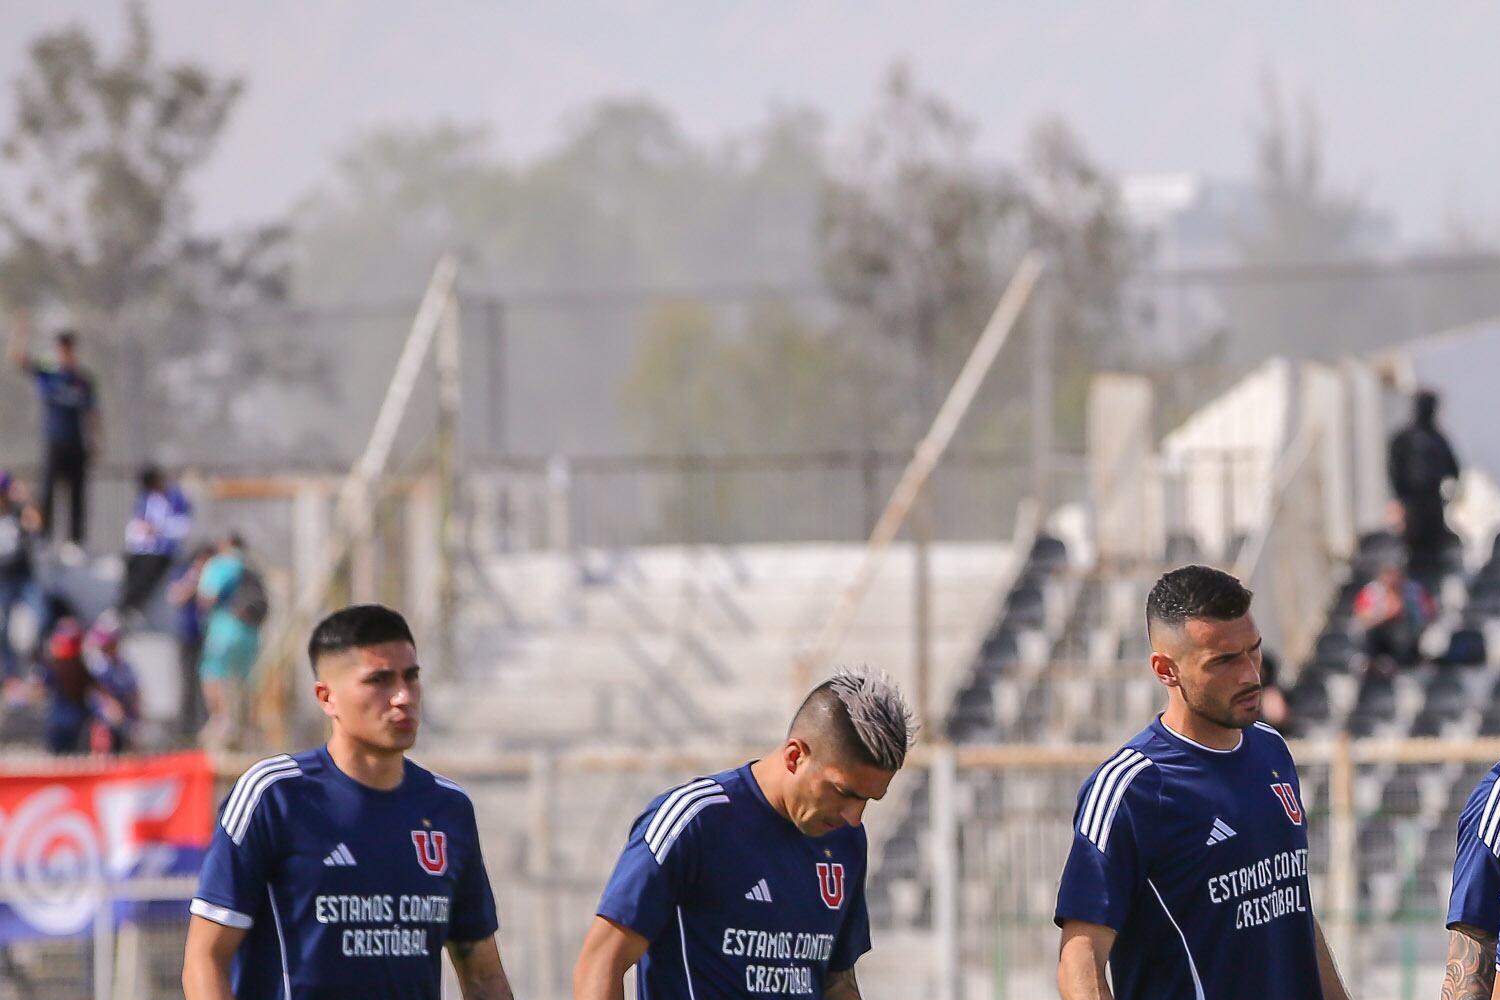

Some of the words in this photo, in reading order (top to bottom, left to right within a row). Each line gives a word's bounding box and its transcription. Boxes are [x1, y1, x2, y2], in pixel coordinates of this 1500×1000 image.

[1270, 783, 1302, 825] U
[411, 830, 447, 876] U
[816, 863, 844, 910] U
[1208, 858, 1271, 904] ESTAMOS
[316, 895, 394, 923] ESTAMOS
[1236, 885, 1306, 929] CRISTÓBAL
[342, 923, 429, 957] CRISTÓBAL
[722, 928, 792, 958] ESTAMOS
